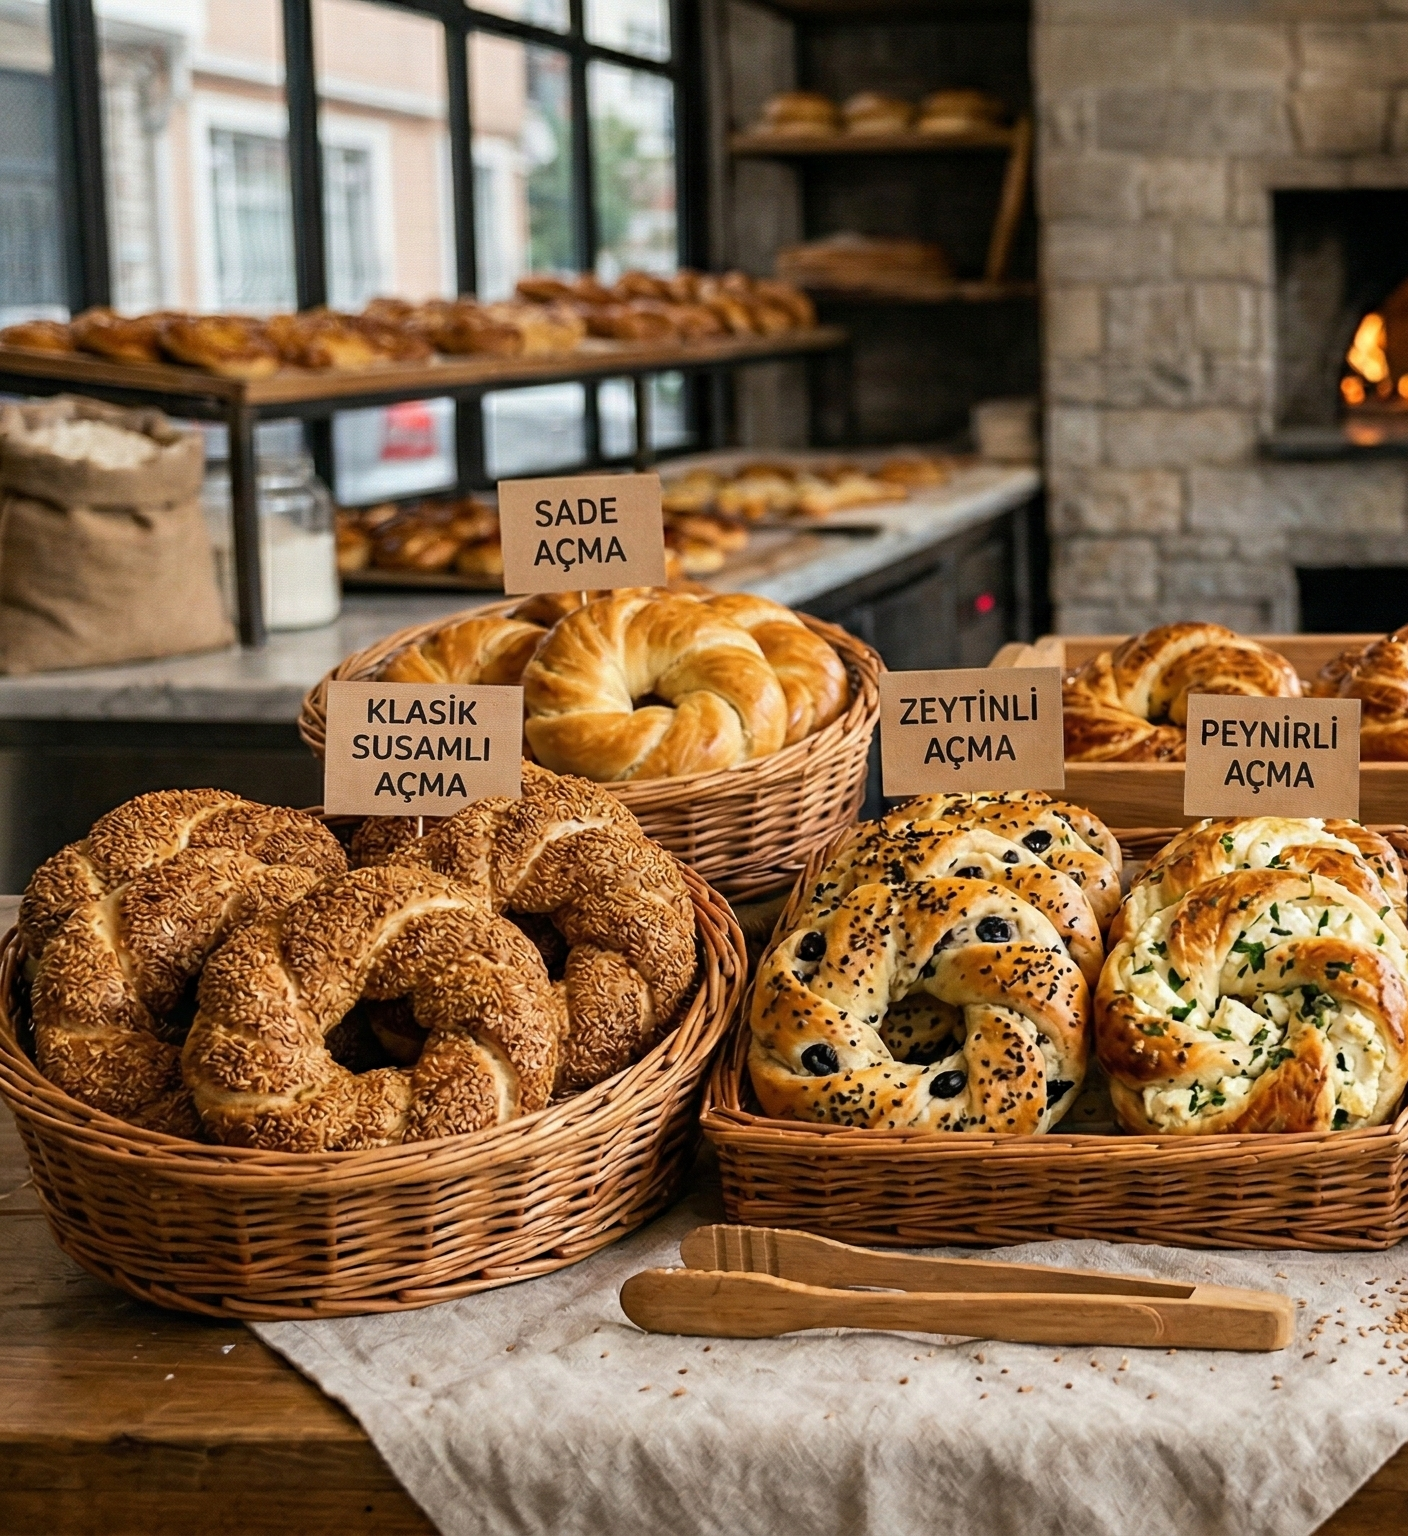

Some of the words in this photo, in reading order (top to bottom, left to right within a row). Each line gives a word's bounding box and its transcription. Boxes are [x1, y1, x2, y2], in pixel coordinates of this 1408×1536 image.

[534, 496, 619, 528] SADE
[533, 535, 627, 573] AÇMA
[367, 694, 478, 726] KLASİK
[899, 686, 1038, 726] ZEYTİNLİ
[351, 734, 491, 763] SUSAMLI
[1201, 714, 1339, 750] PEYNİRLİ
[923, 734, 1018, 771] AÇMA
[374, 770, 468, 804] AÇMA
[1223, 759, 1316, 795] AÇMA
